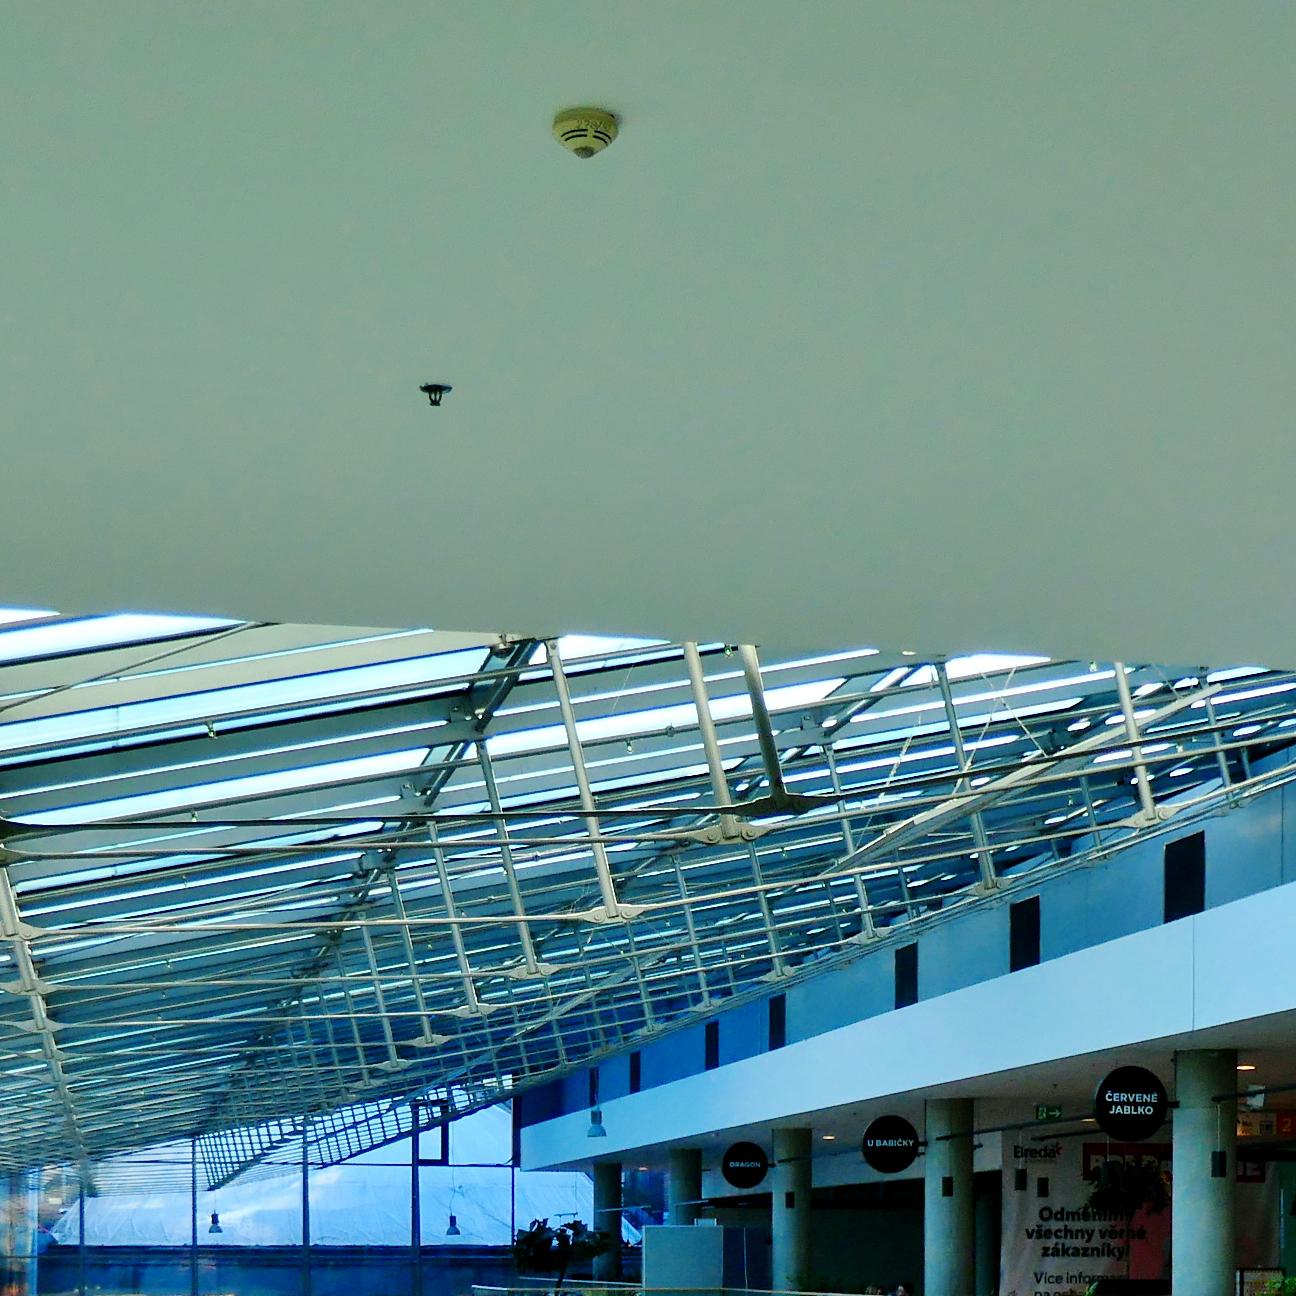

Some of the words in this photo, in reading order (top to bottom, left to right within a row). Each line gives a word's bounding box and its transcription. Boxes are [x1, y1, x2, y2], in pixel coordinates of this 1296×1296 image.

[1105, 1090, 1158, 1103] ČERVENÉ
[1109, 1105, 1154, 1115] JABLKO
[867, 1139, 874, 1147] U
[875, 1137, 914, 1147] BABIČKY
[1025, 1225, 1097, 1243] všechny
[1034, 1272, 1063, 1284] Více
